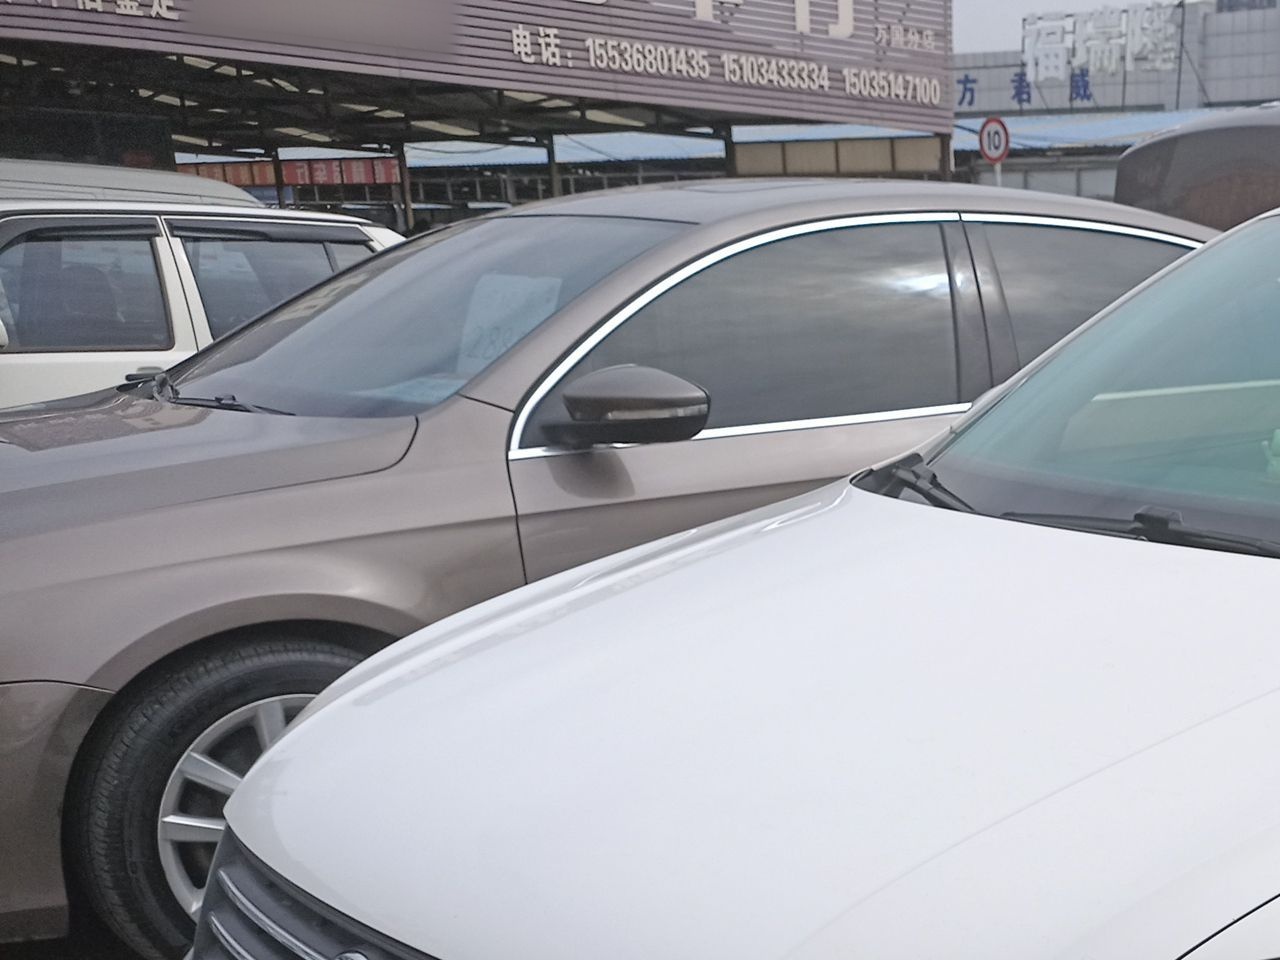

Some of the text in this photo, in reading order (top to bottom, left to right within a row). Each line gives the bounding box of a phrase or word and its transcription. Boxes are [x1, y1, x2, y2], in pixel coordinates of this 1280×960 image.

[585, 38, 710, 79] 15536801435
[720, 53, 830, 91] 15103433334
[841, 67, 941, 105] 15035147100
[987, 130, 1001, 150] 10
